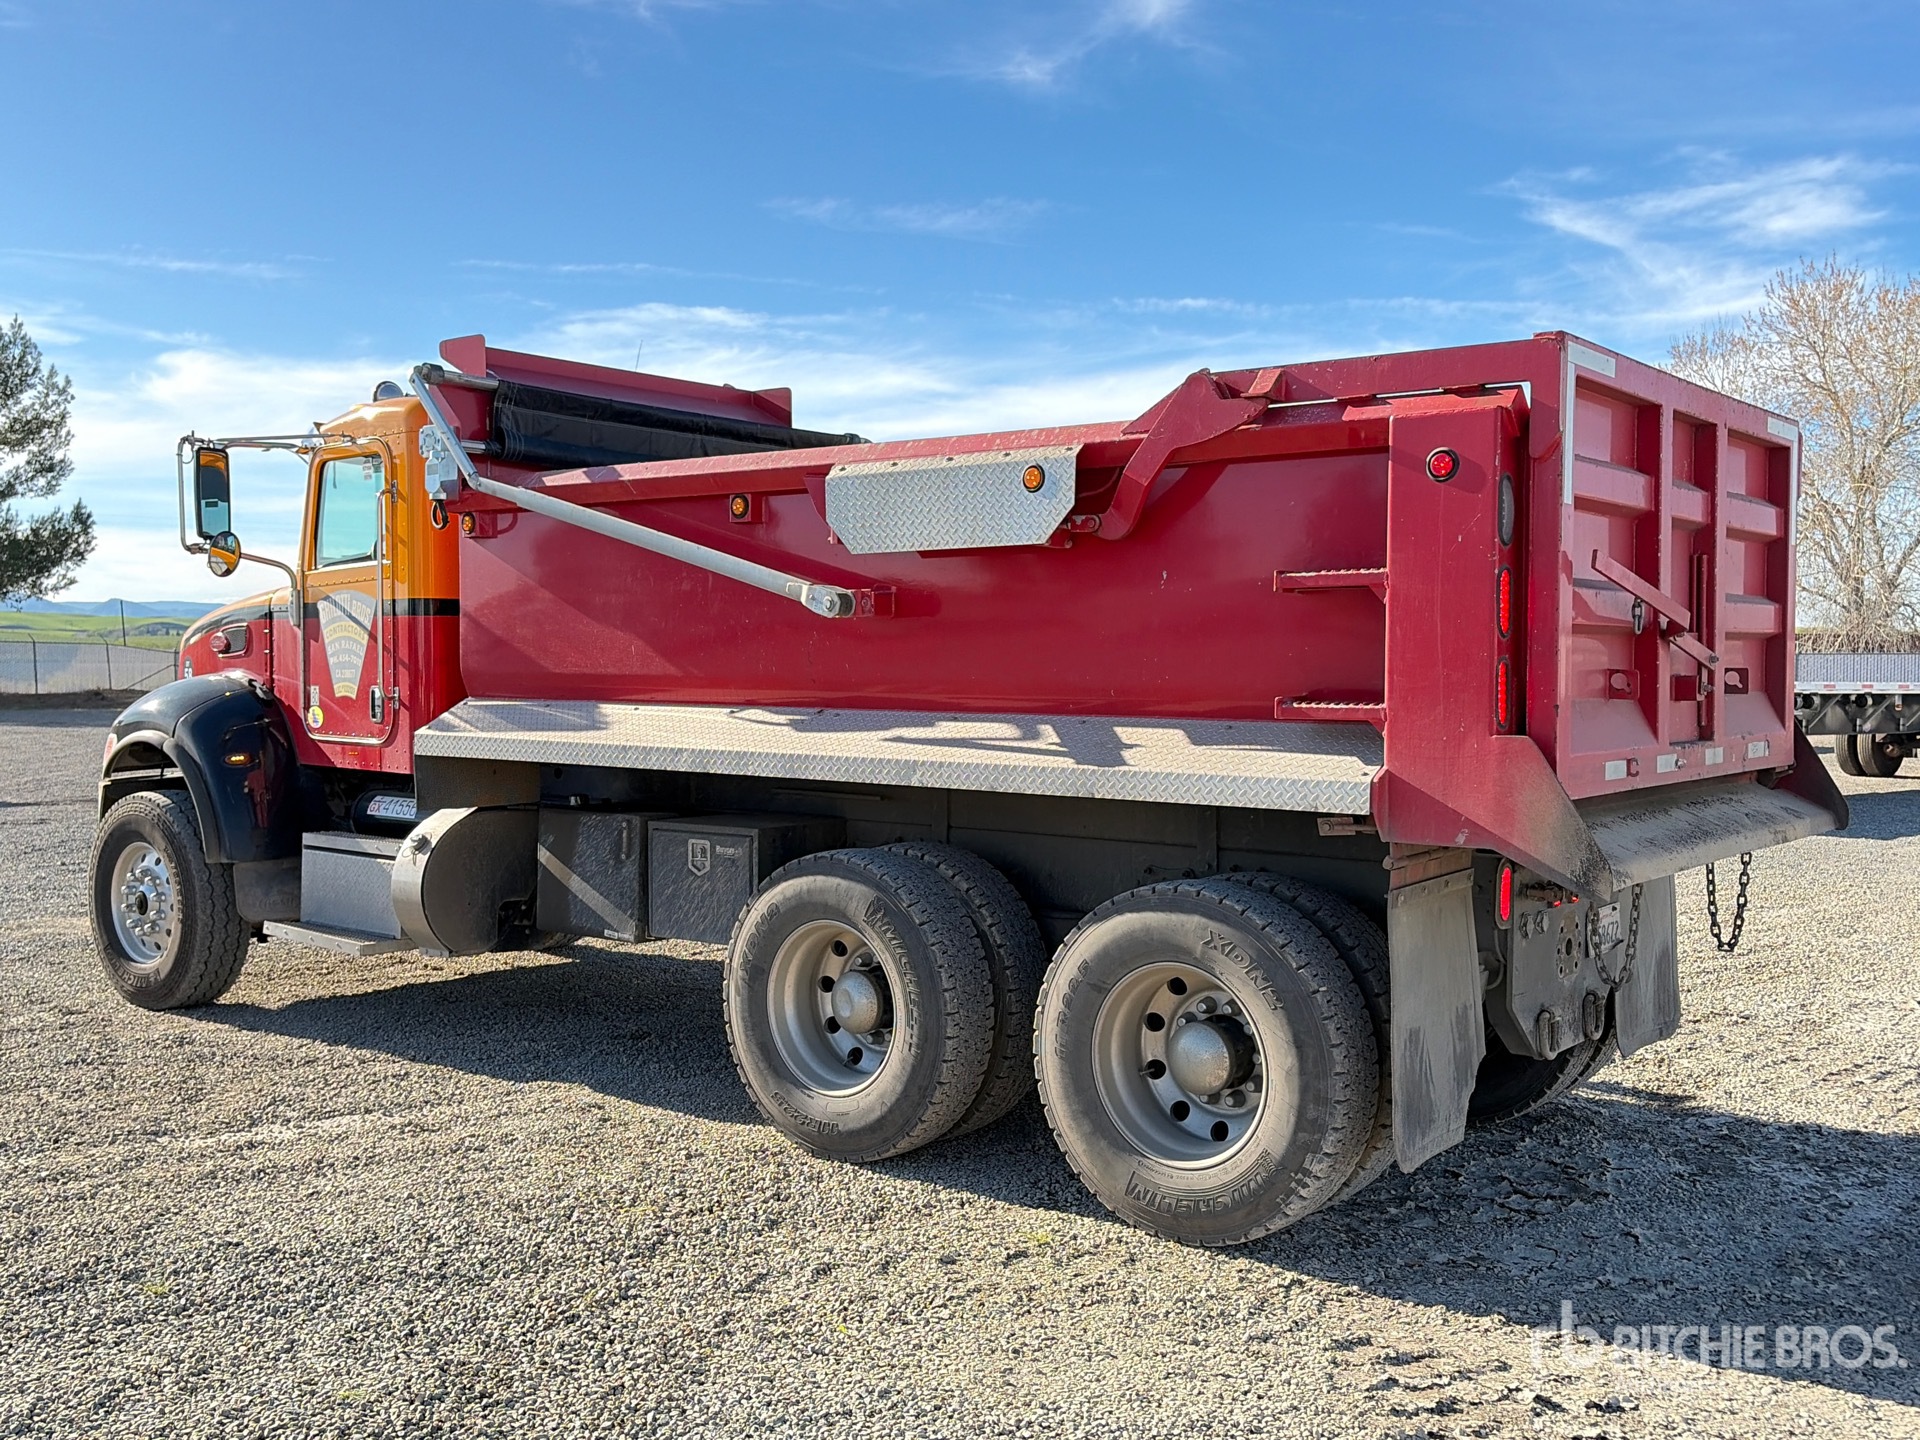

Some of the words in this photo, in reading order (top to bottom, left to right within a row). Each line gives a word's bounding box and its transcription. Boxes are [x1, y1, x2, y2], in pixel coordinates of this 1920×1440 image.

[326, 624, 366, 641] CONTRACTORS
[327, 641, 340, 655] SAN
[341, 640, 364, 656] RAFAEL
[106, 948, 147, 987] MICHELIN
[1201, 928, 1285, 1011] XDN2
[880, 921, 921, 1056] MICHELIN
[1128, 1172, 1268, 1216] MICHELIN
